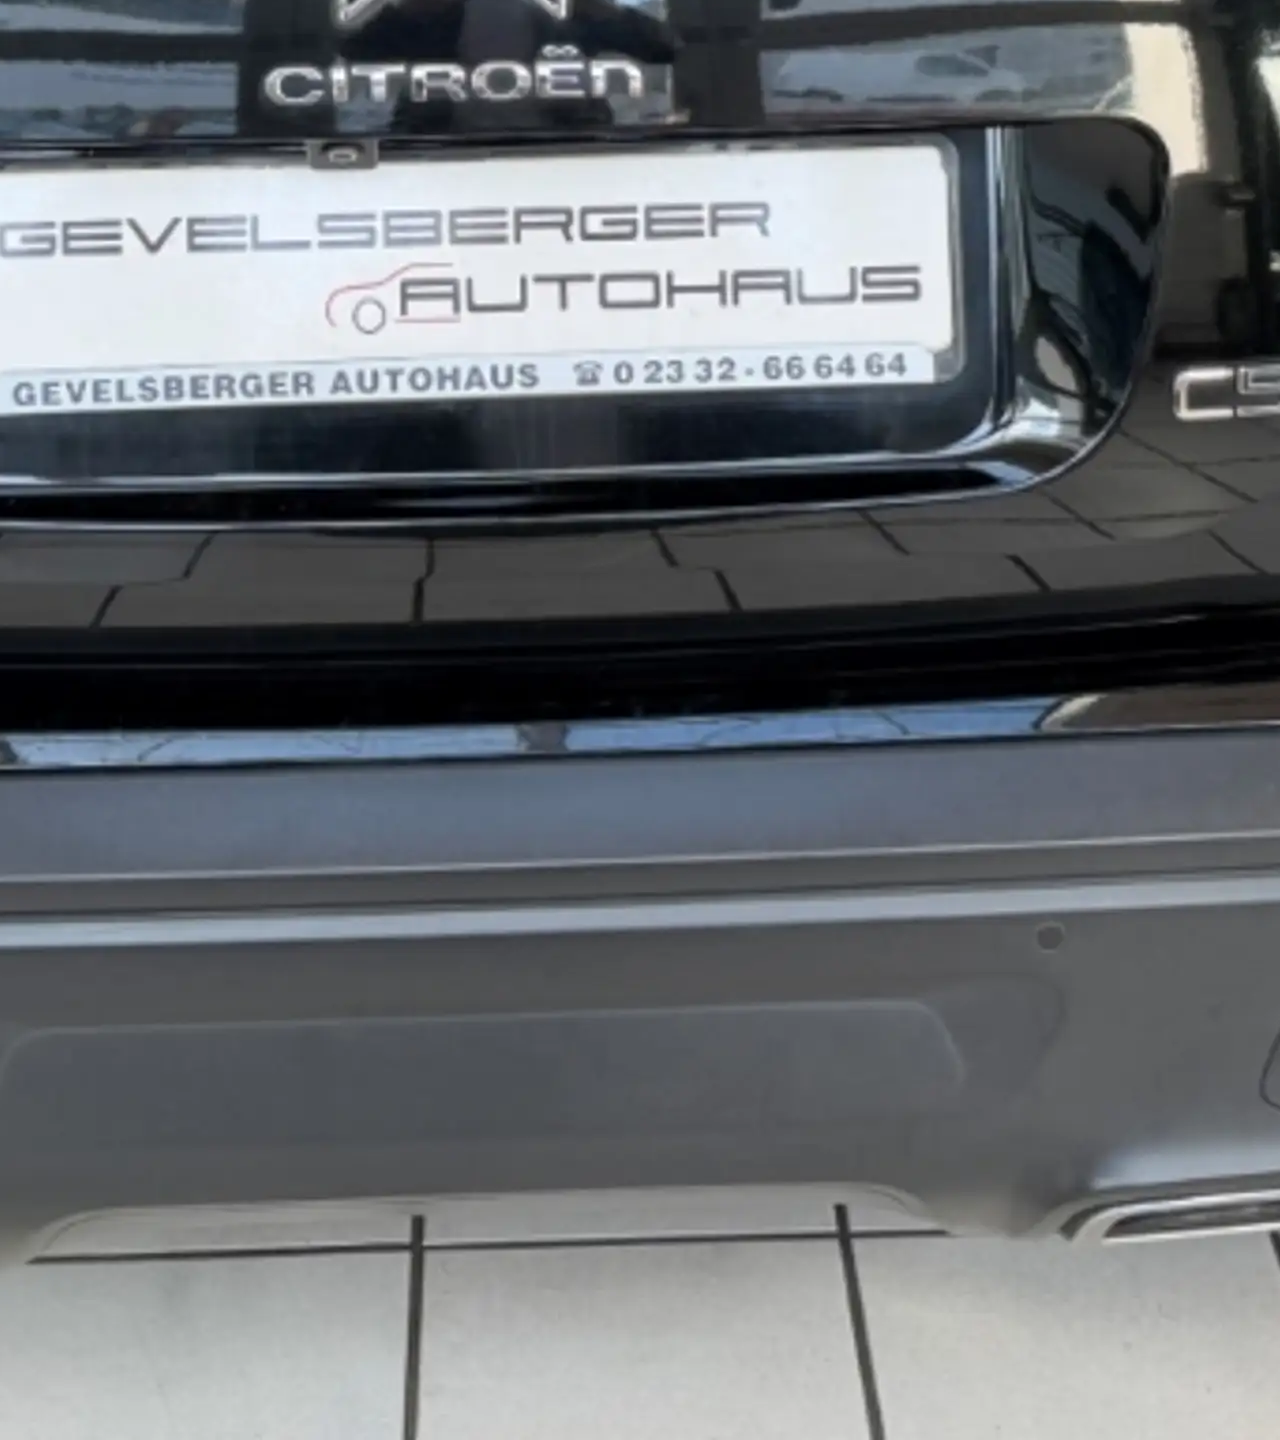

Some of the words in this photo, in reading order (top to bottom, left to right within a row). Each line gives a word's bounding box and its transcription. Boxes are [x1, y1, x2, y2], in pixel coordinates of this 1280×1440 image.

[399, 265, 922, 317] AUTOHAUS
[12, 370, 315, 408] GEVELSBERGER
[329, 363, 540, 395] AUTOHAUS
